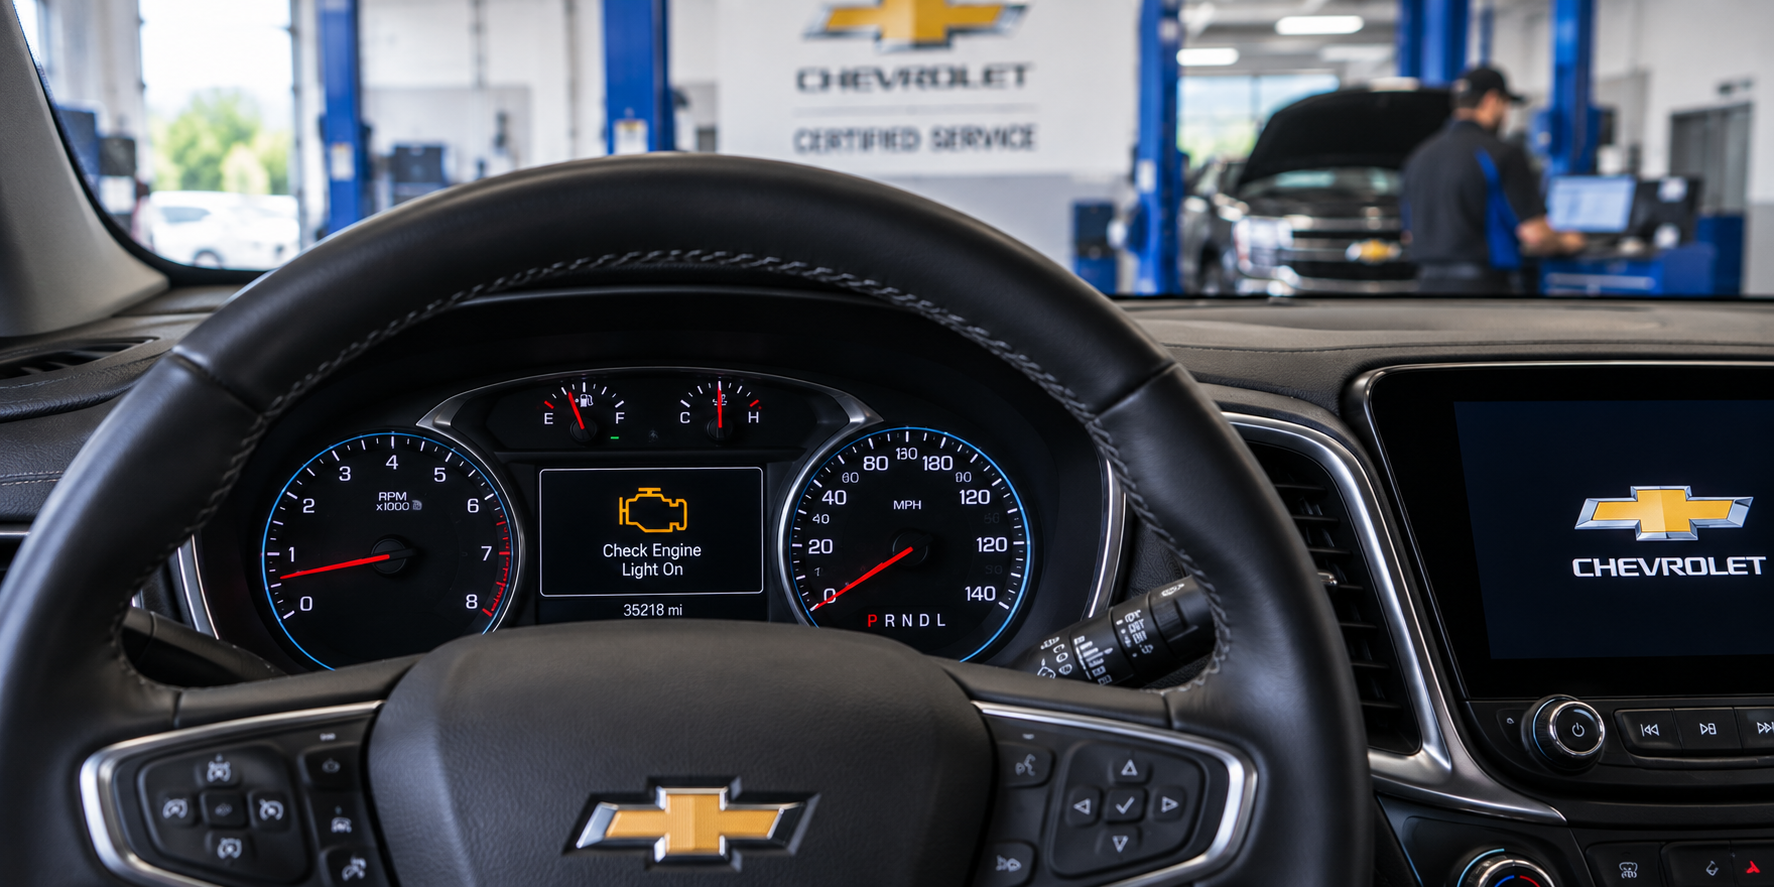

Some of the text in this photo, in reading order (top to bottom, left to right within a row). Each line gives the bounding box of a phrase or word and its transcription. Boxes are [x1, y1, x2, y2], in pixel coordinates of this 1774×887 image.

[796, 62, 1032, 92] CHEVROLET
[794, 123, 1037, 154] CERTIFIED SERVICE
[543, 412, 554, 425] E
[615, 411, 625, 425] F
[679, 411, 691, 424] C
[747, 411, 760, 424] H
[385, 454, 399, 470] 4
[862, 456, 889, 470] 80
[338, 465, 352, 482] 3
[433, 466, 447, 483] 5
[378, 491, 408, 502] RPM
[821, 490, 847, 505] 40
[959, 490, 991, 504] 120
[302, 497, 315, 514] 2
[375, 501, 411, 511] x1000
[467, 497, 480, 514] 6
[893, 500, 922, 509] MPH
[602, 542, 702, 561] Check Engine
[808, 539, 834, 554] 20
[976, 537, 1008, 552] 120
[288, 546, 295, 563] 1
[480, 545, 493, 562] 7
[622, 562, 684, 579] Light On
[1572, 556, 1767, 577] CHEVROLET
[823, 587, 837, 604] 0
[964, 586, 996, 601] 140
[299, 595, 313, 612] 0
[465, 593, 478, 610] 8
[623, 604, 683, 616] 35218 mi
[867, 613, 946, 628] P R N D L
